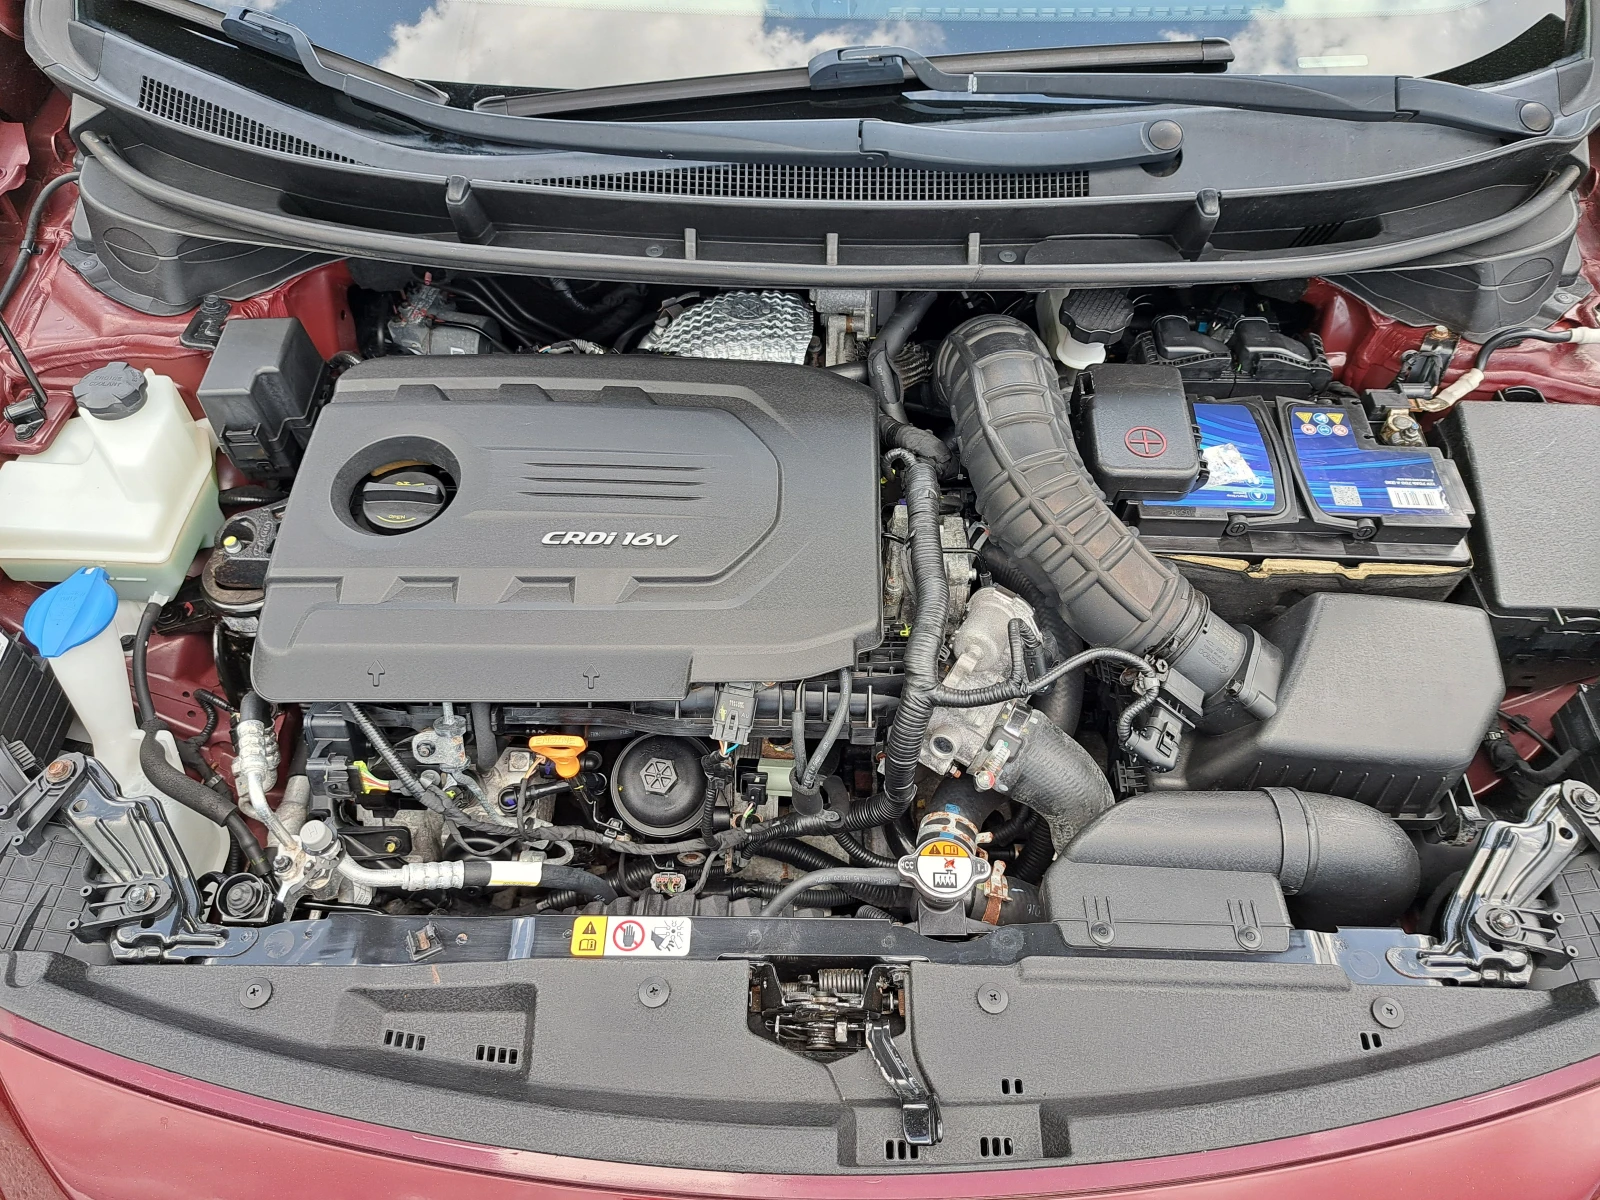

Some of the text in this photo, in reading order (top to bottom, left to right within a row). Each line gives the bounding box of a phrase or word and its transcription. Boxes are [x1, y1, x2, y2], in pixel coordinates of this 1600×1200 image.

[541, 531, 679, 546] CRDi 16V
[535, 736, 576, 745] ENGINE
